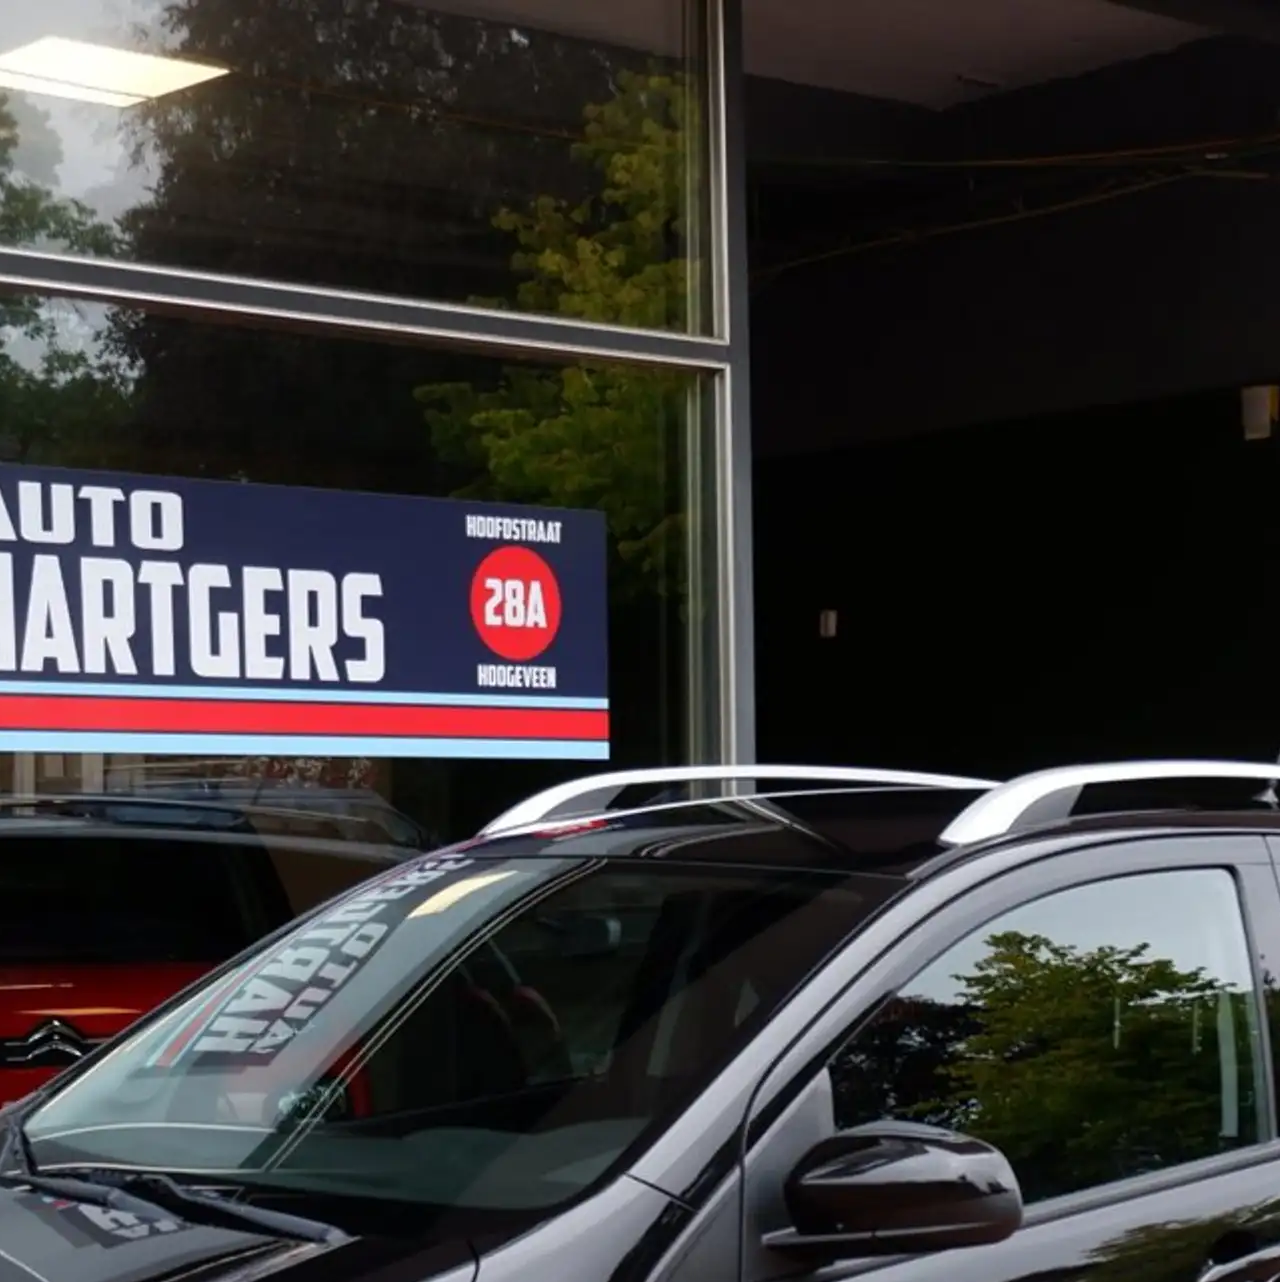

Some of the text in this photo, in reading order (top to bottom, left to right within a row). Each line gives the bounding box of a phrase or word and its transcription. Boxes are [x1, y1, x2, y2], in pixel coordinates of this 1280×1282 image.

[466, 514, 562, 543] HOOFDSTRAAT
[484, 577, 548, 628] 28A
[477, 664, 557, 688] HOOGEVEEN
